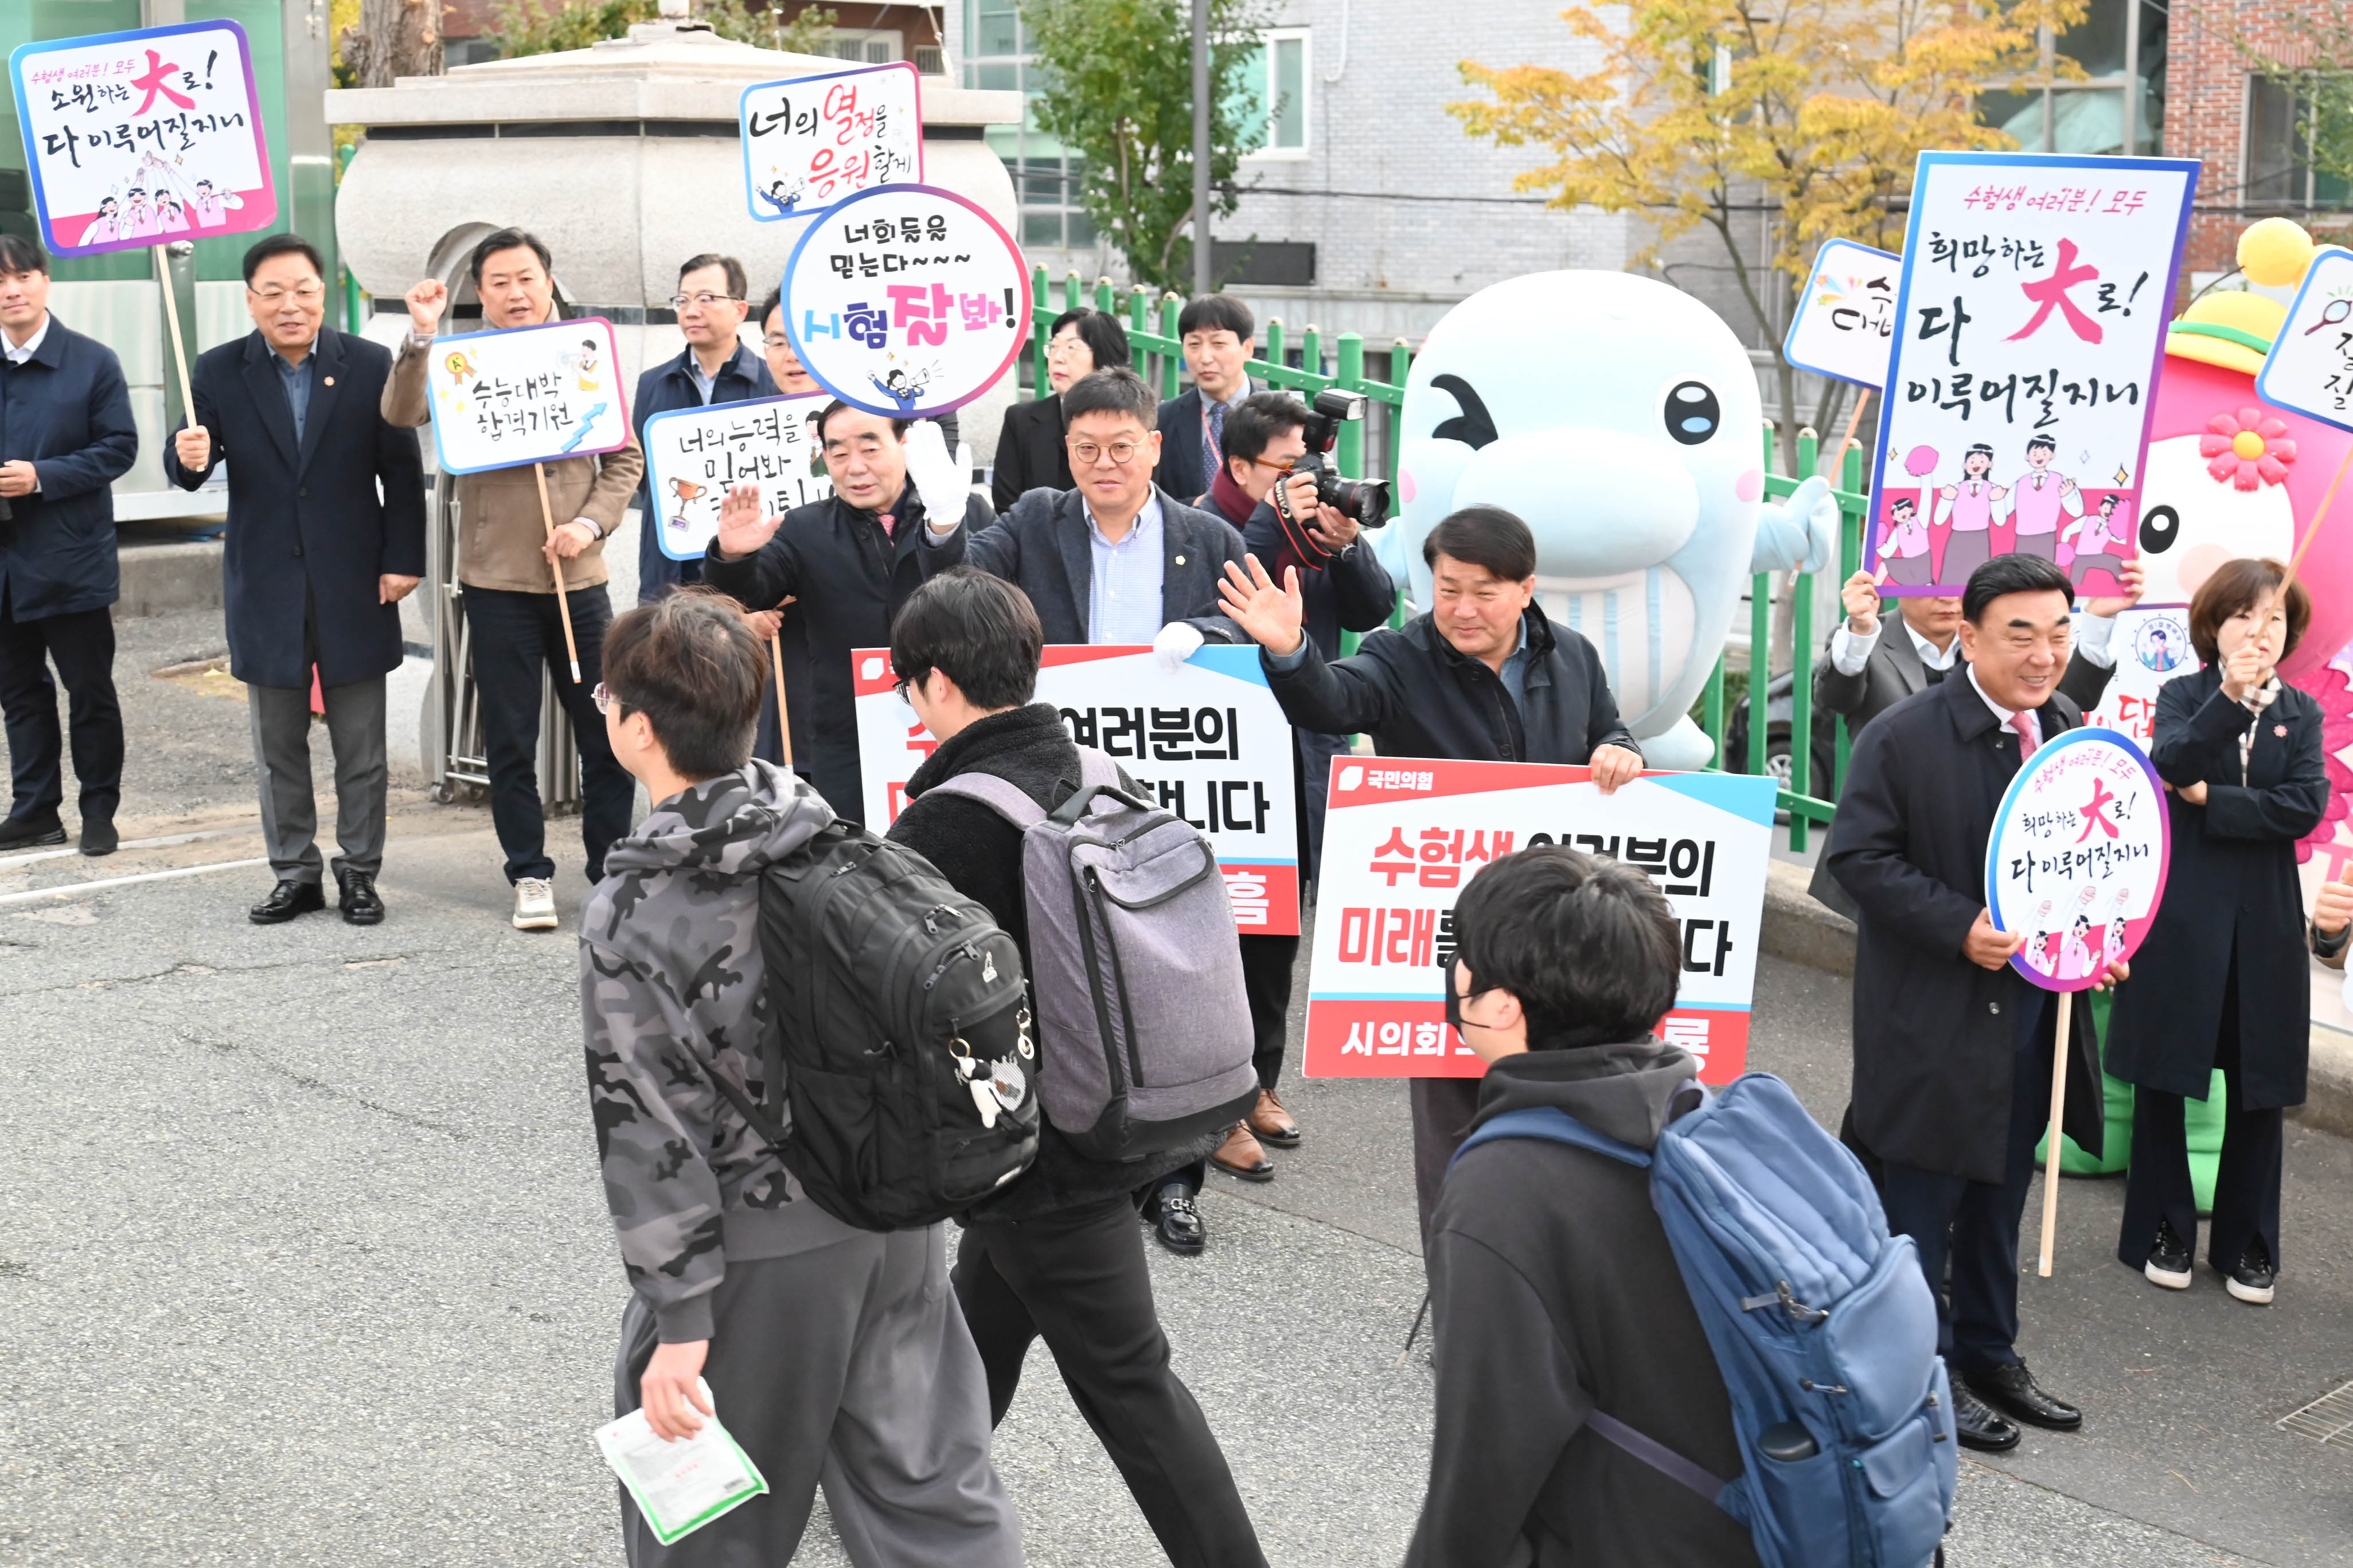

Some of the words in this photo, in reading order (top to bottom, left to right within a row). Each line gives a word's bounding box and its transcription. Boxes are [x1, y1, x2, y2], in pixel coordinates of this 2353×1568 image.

[31, 68, 64, 85] 수험생
[112, 60, 135, 75] 모두
[52, 84, 130, 113] 소원하는
[750, 97, 818, 138] 너의
[824, 84, 888, 146] 열정을
[1964, 185, 2027, 213] 수험생
[2027, 187, 2101, 214] 여러분!
[2102, 190, 2148, 216] 모두
[844, 214, 947, 244] 너희들을
[1929, 231, 2044, 278] 희망하는
[1918, 296, 1971, 366] 다
[1907, 368, 2139, 428] 이루어질지니
[1059, 707, 1239, 760] 여러분의
[1367, 768, 1434, 792] 국민의힘
[2110, 758, 2137, 781] 모두
[2022, 811, 2077, 838] 희망하는
[1341, 1022, 1448, 1056] 시의회
